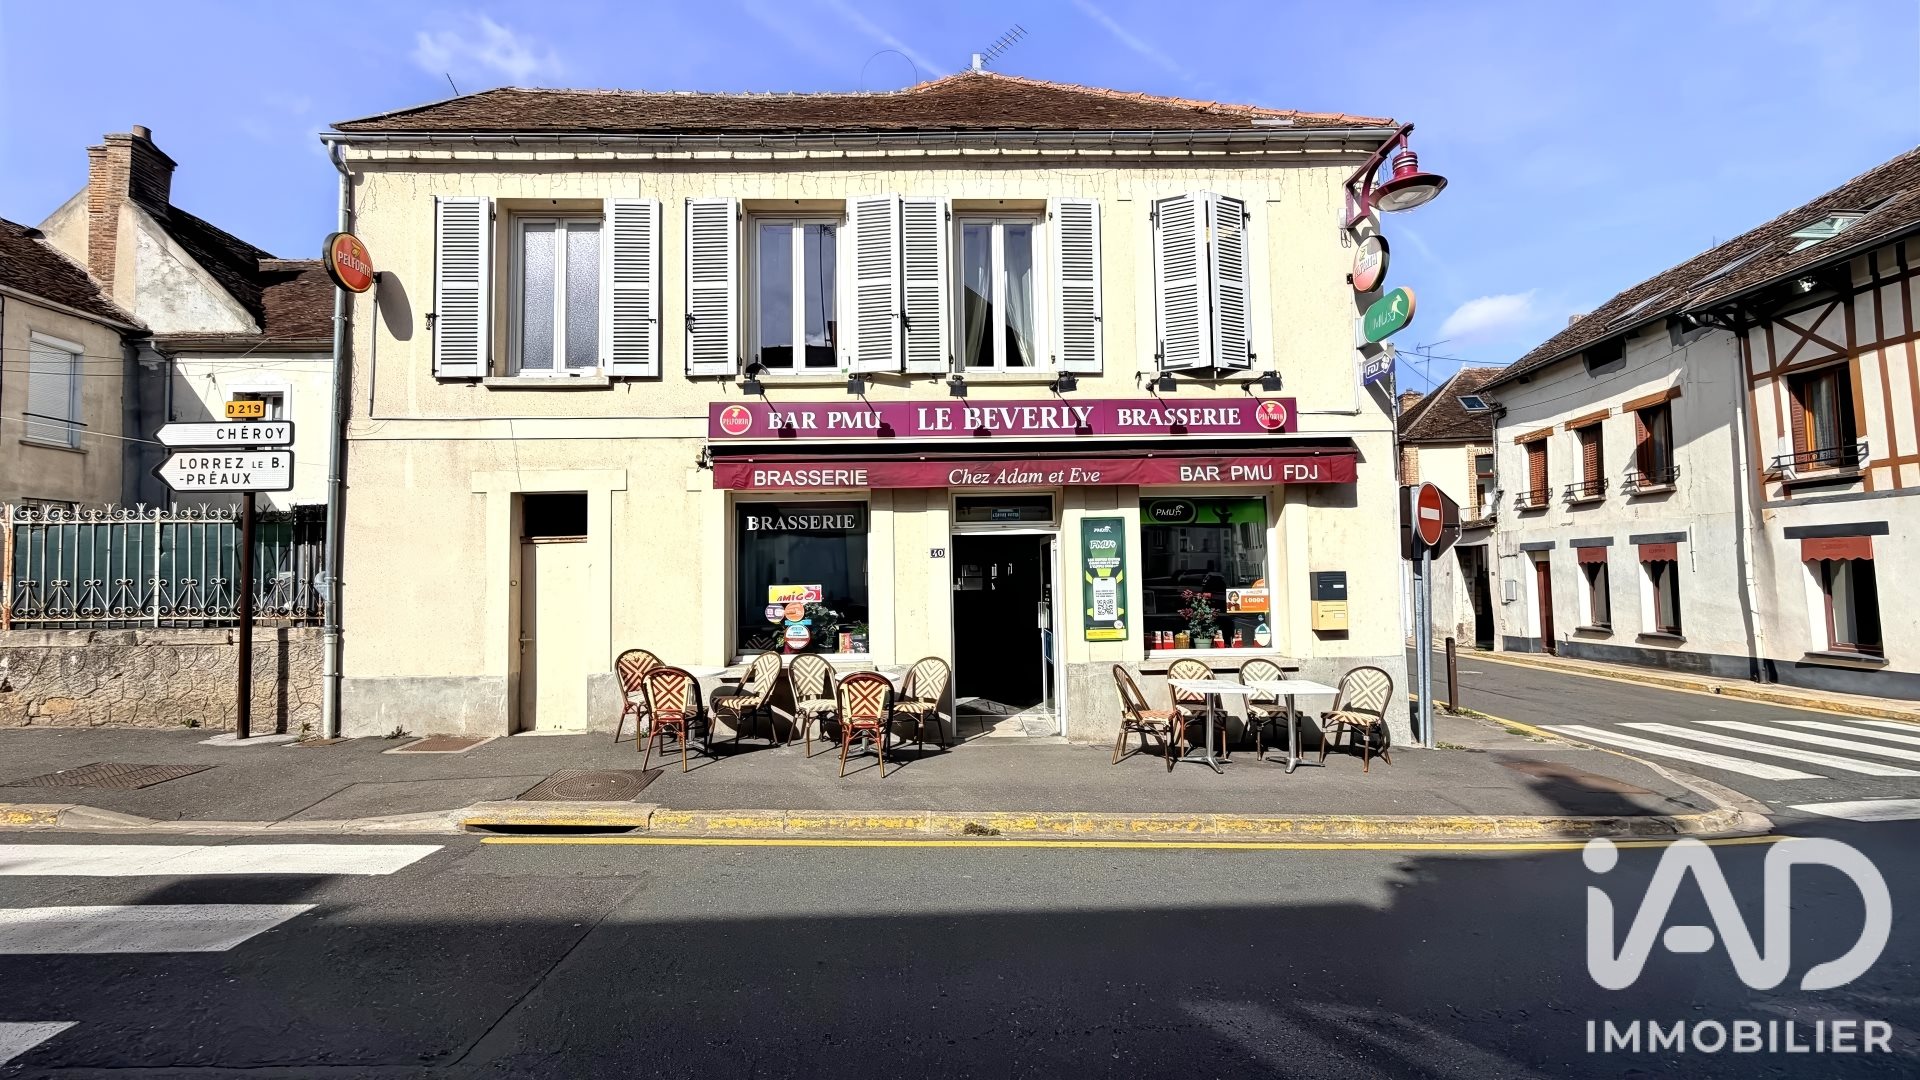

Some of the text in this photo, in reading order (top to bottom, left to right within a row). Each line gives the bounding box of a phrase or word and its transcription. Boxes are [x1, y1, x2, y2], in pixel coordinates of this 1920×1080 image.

[1367, 362, 1379, 376] FDJ
[227, 404, 261, 414] D 219
[1117, 407, 1241, 426] BRASSERIE
[768, 411, 882, 430] BAR PMU
[917, 405, 1094, 431] LE BEVERLY
[216, 425, 285, 440] CHÉROY
[179, 456, 285, 470] LORREZ LE B.
[754, 469, 868, 486] BRASSERIE
[948, 467, 1100, 485] Chez Adam et Eve
[1180, 464, 1318, 482] BAR PMU FDJ
[1155, 508, 1175, 516] PMU
[746, 514, 856, 531] BRASSERIE
[932, 549, 944, 558] 40
